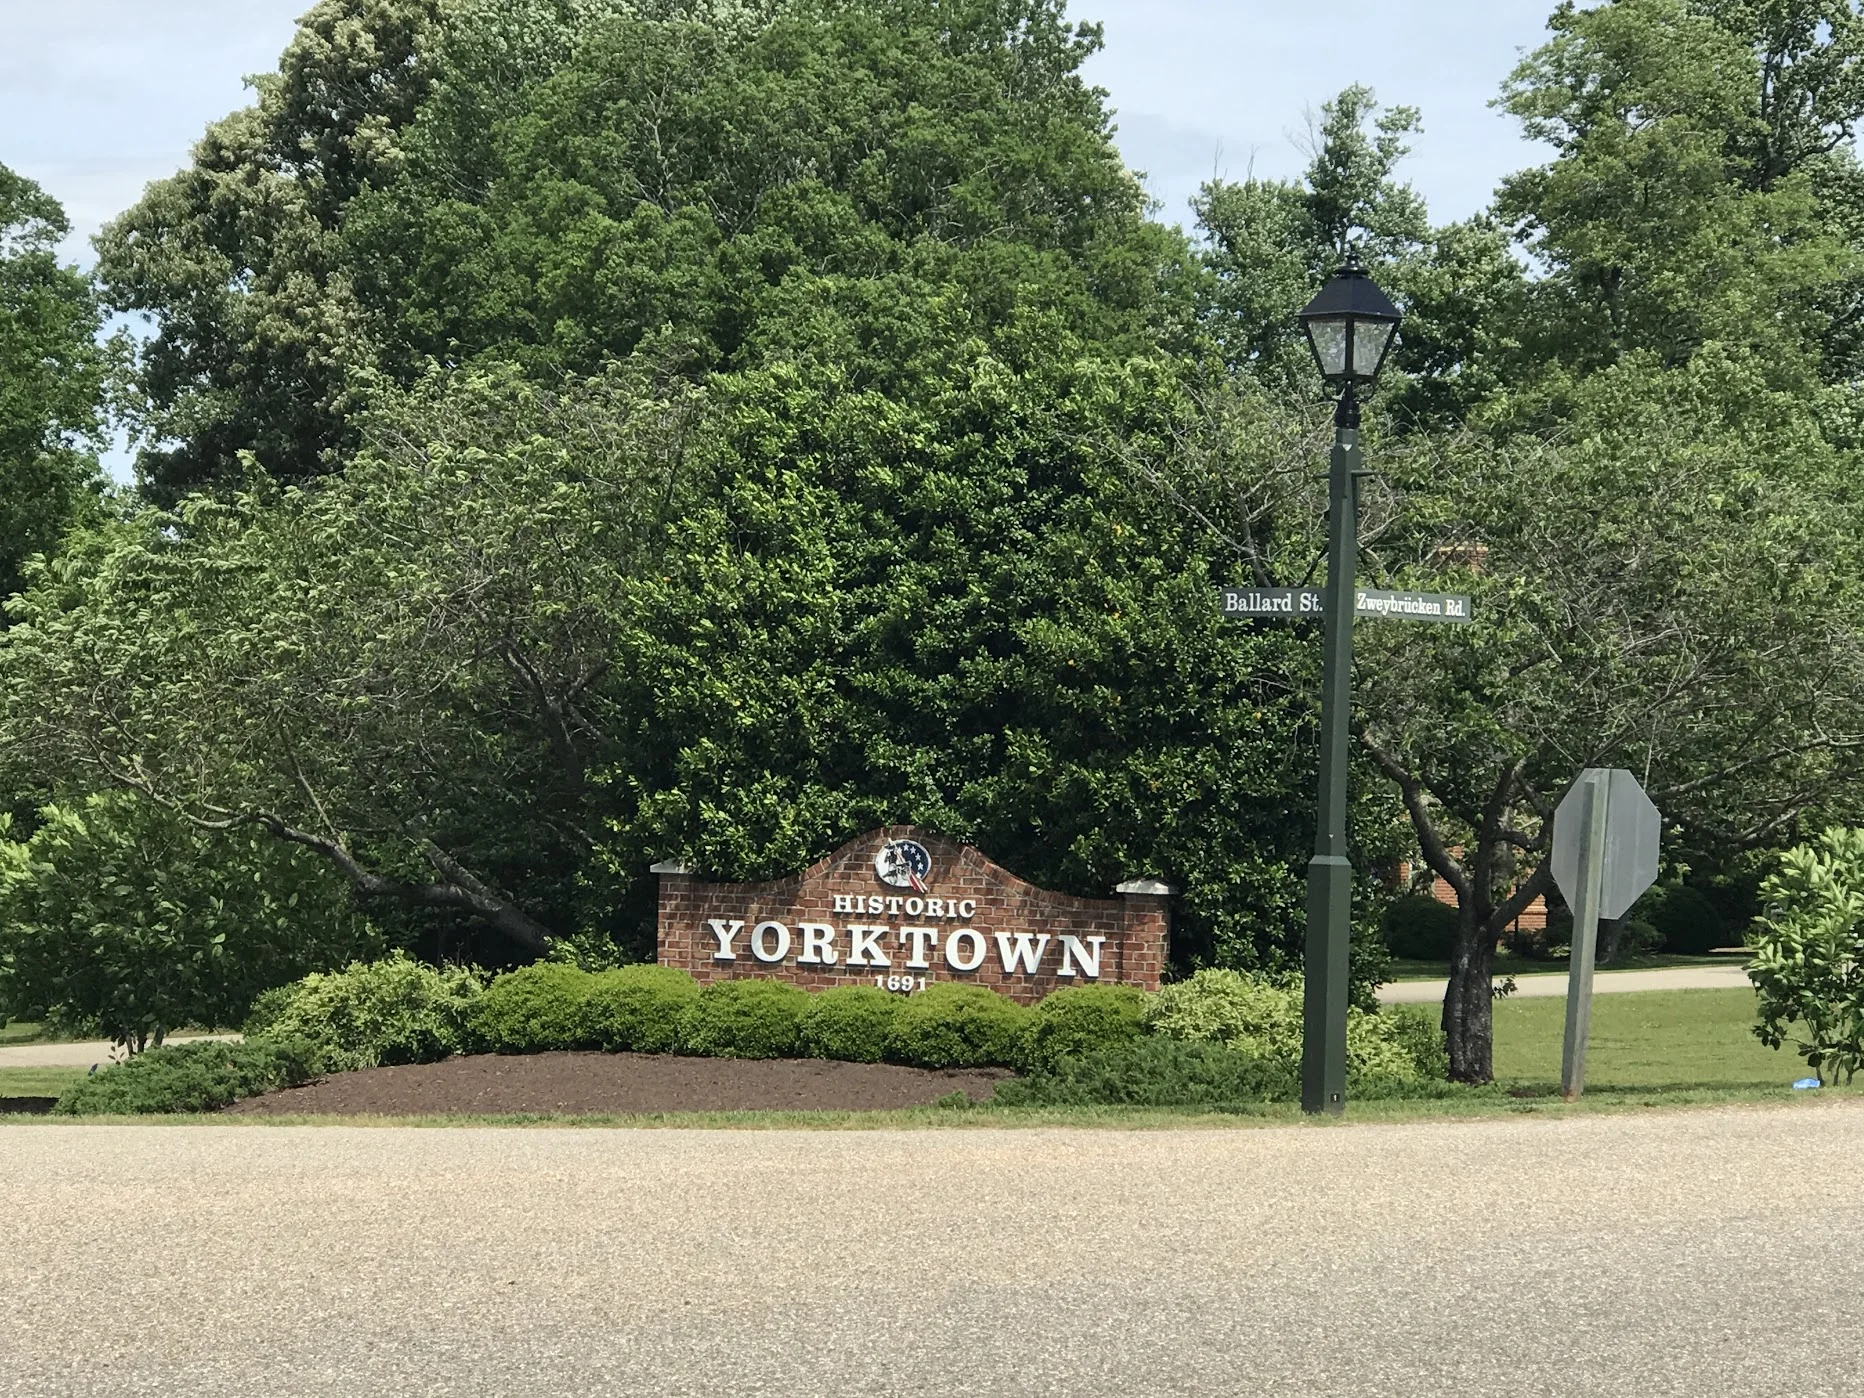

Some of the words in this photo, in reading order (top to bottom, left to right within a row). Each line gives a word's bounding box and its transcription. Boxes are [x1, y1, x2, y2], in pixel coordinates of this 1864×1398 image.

[1225, 593, 1293, 612] Ballard
[1301, 593, 1324, 612] St.
[1357, 593, 1441, 616] Zweybrücken
[1446, 598, 1466, 617] Rd.
[833, 894, 976, 919] HISTORIC
[708, 918, 1105, 978] YORKTOWN
[875, 975, 926, 992] 1691
